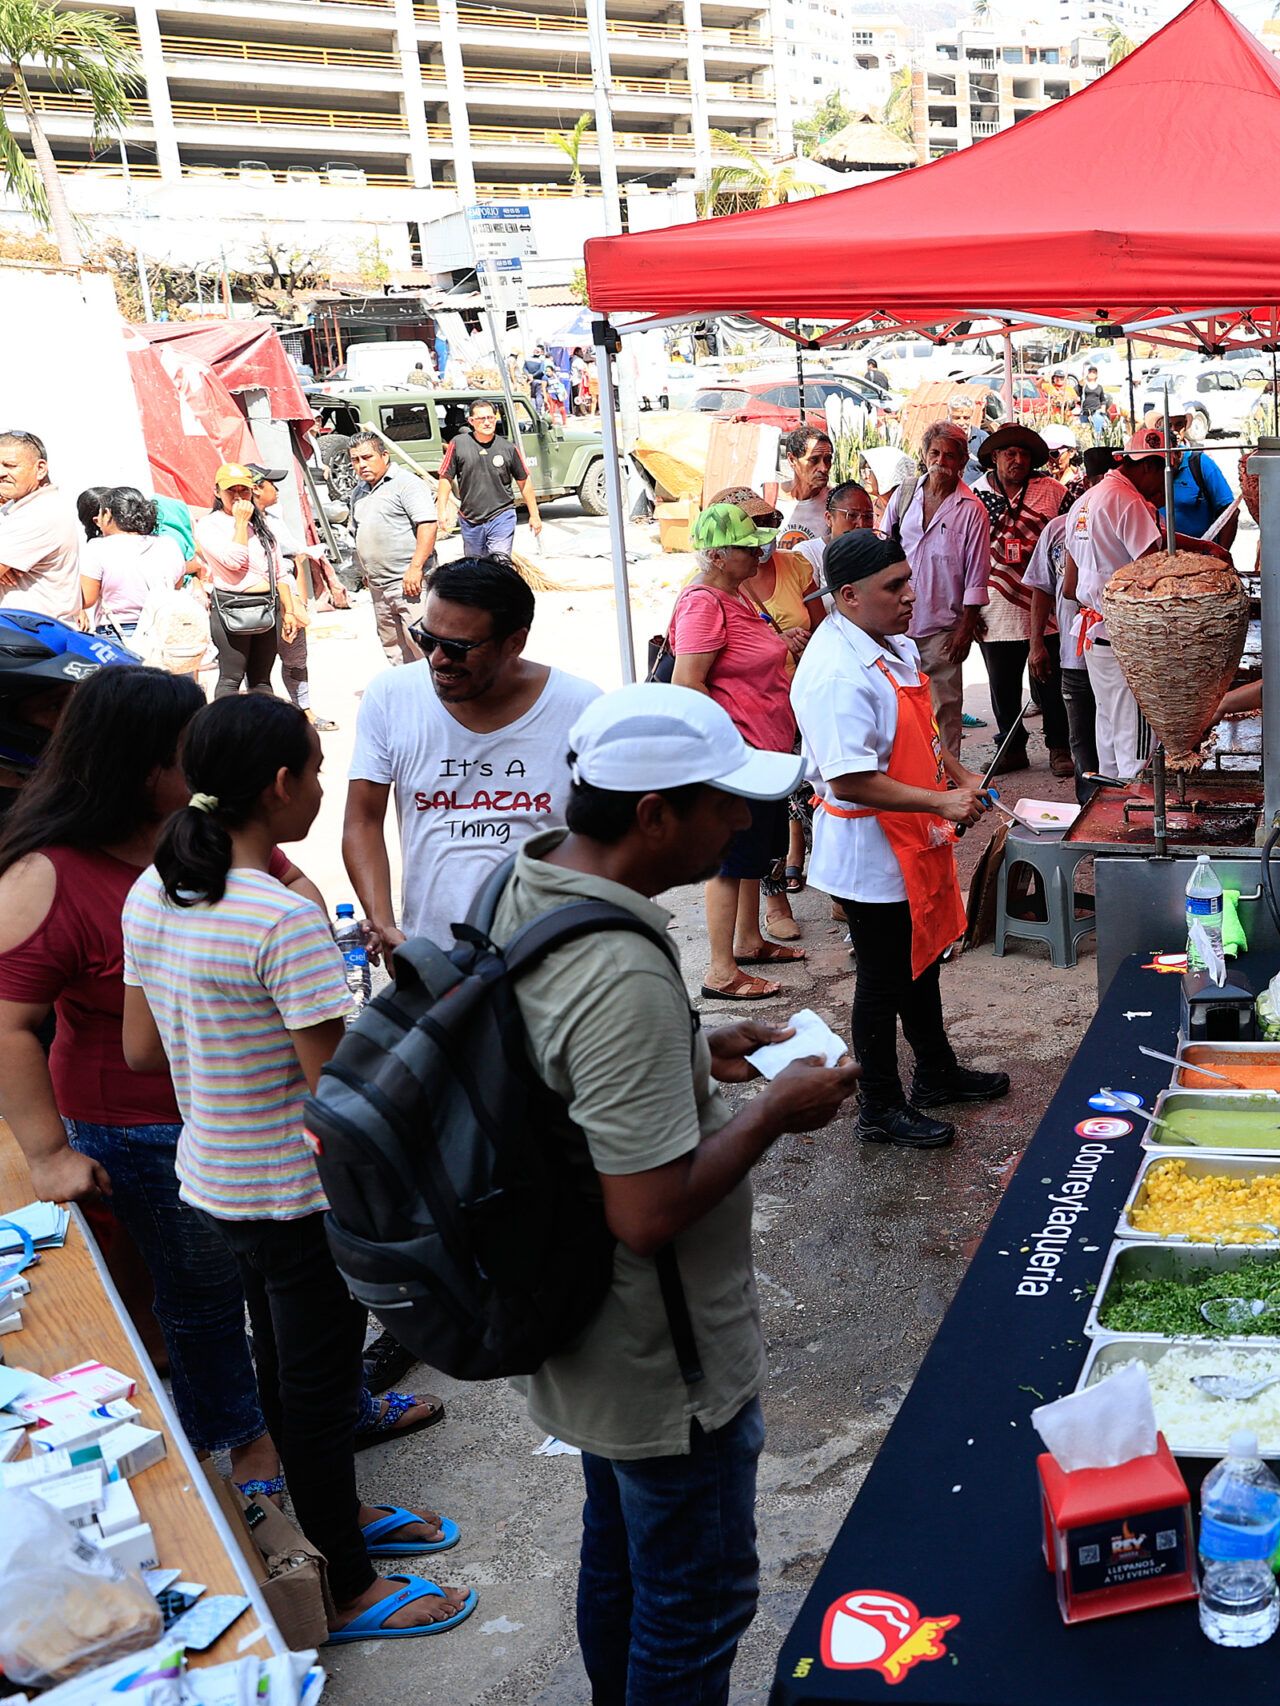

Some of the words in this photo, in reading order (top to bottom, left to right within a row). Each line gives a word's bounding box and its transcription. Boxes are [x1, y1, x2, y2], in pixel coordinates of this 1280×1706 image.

[505, 759, 527, 778] A
[414, 790, 552, 815] SALAZAR
[444, 820, 511, 845] Thing
[1016, 1142, 1115, 1297] donreytaqueria
[1113, 1572, 1125, 1581] TU
[1126, 1566, 1161, 1579] EVENTO
[792, 1658, 814, 1678] MR
